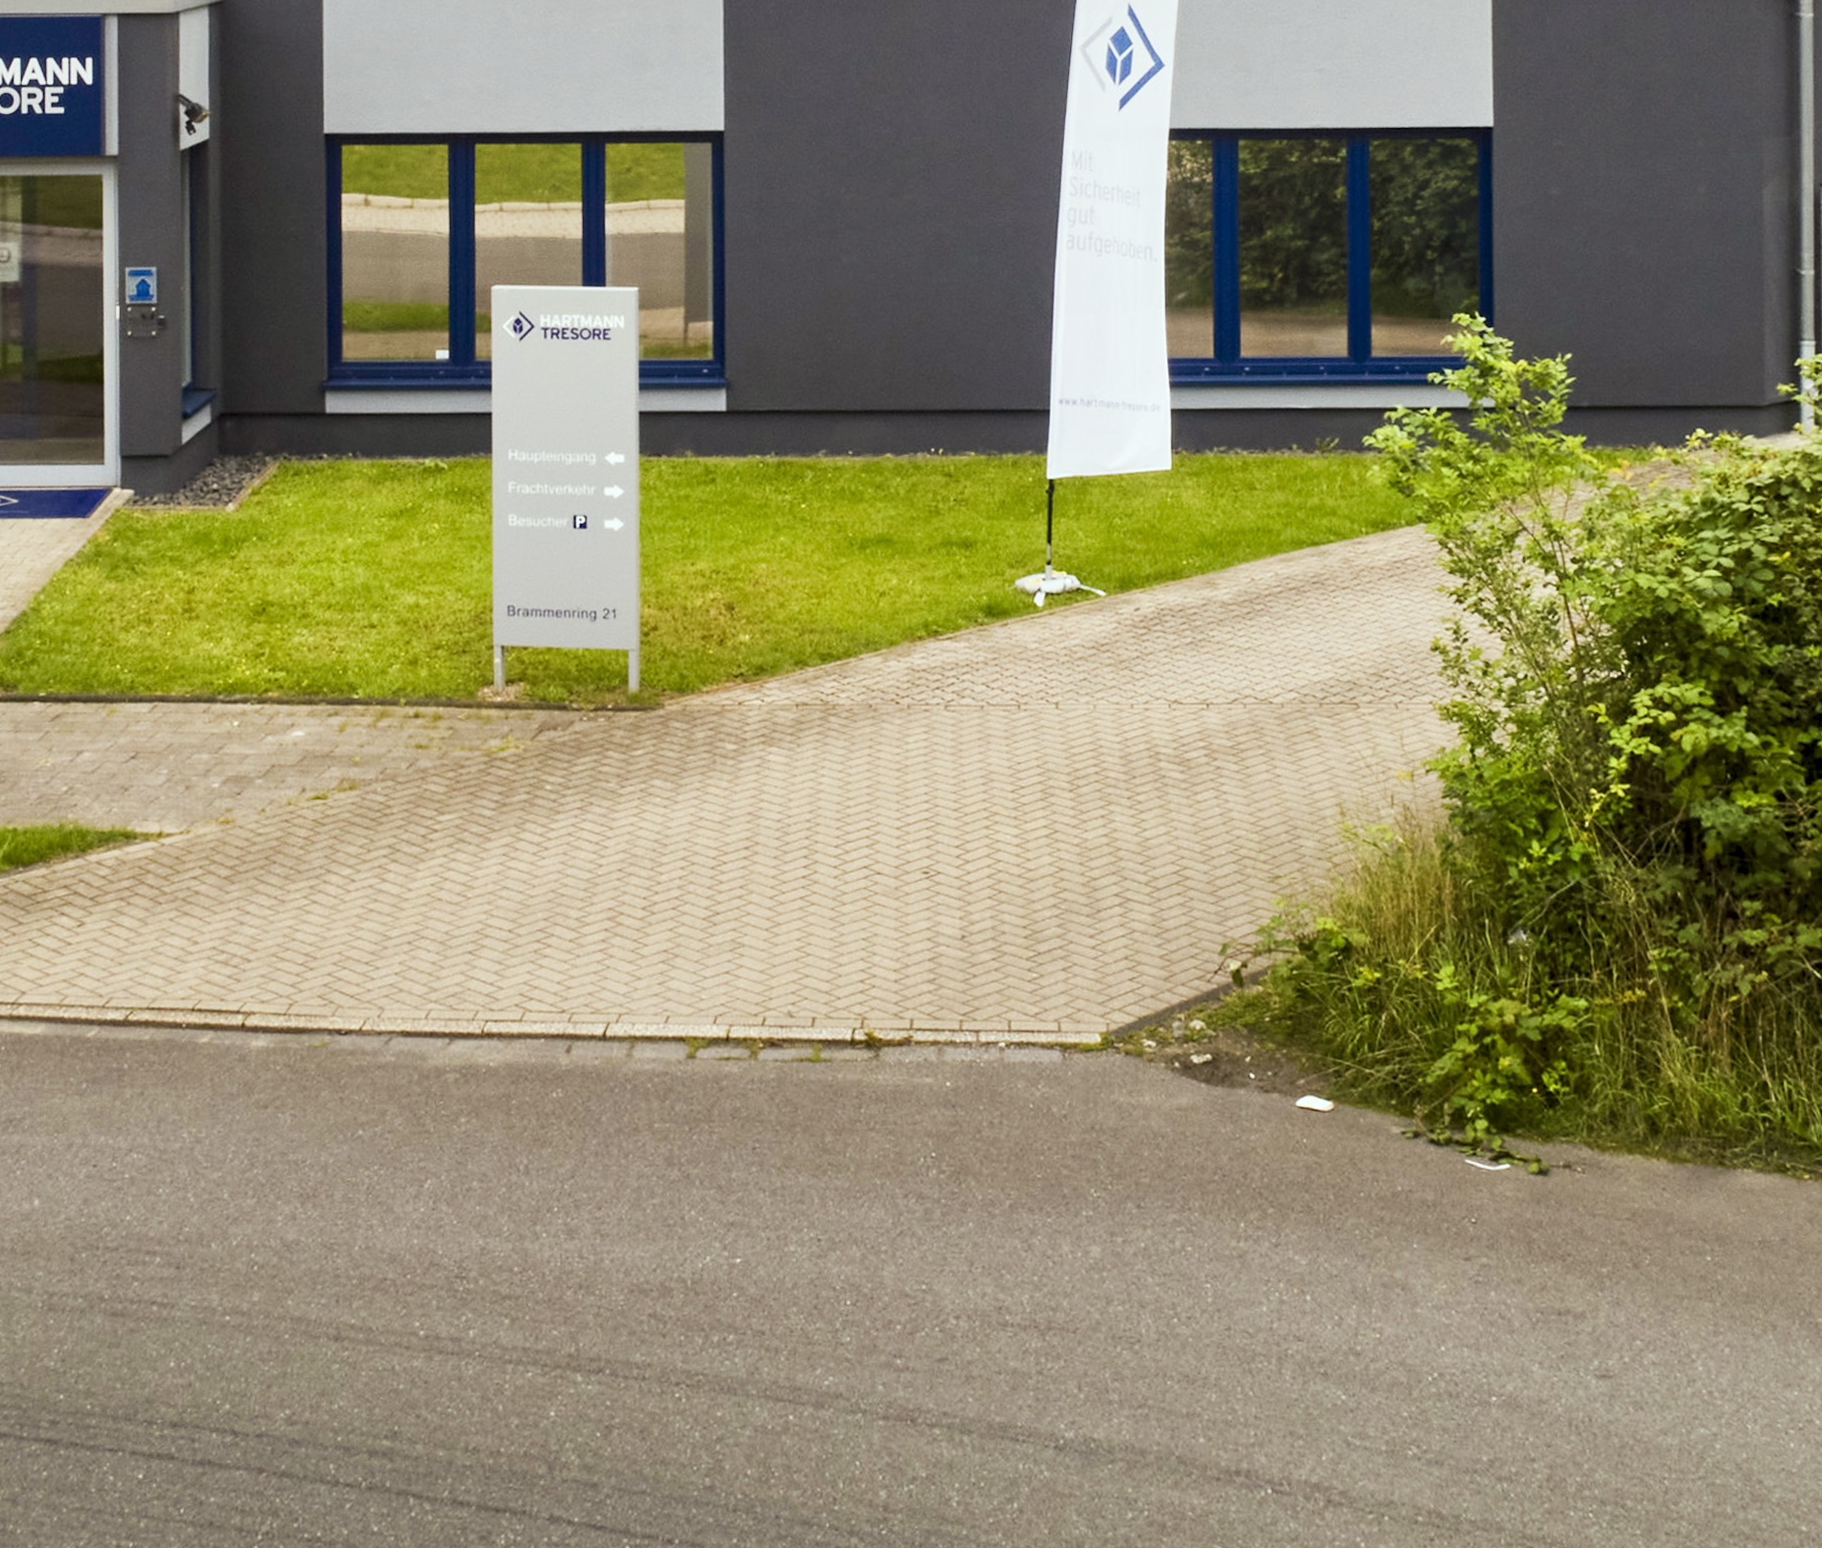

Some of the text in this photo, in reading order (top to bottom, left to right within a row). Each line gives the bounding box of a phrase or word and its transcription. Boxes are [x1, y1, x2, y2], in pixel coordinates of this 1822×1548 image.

[1071, 150, 1093, 172] Mit
[1068, 176, 1141, 207] Sicherheit
[1067, 205, 1095, 228] gut
[1066, 231, 1158, 262] aufgehoben.
[540, 314, 625, 328] HARTMANN
[541, 327, 611, 341] TRESORE
[508, 449, 596, 465] Haupteingang
[508, 481, 595, 495] Frachtverkehr
[508, 514, 586, 529] Besucher P
[506, 605, 617, 622] Brammenring 21
